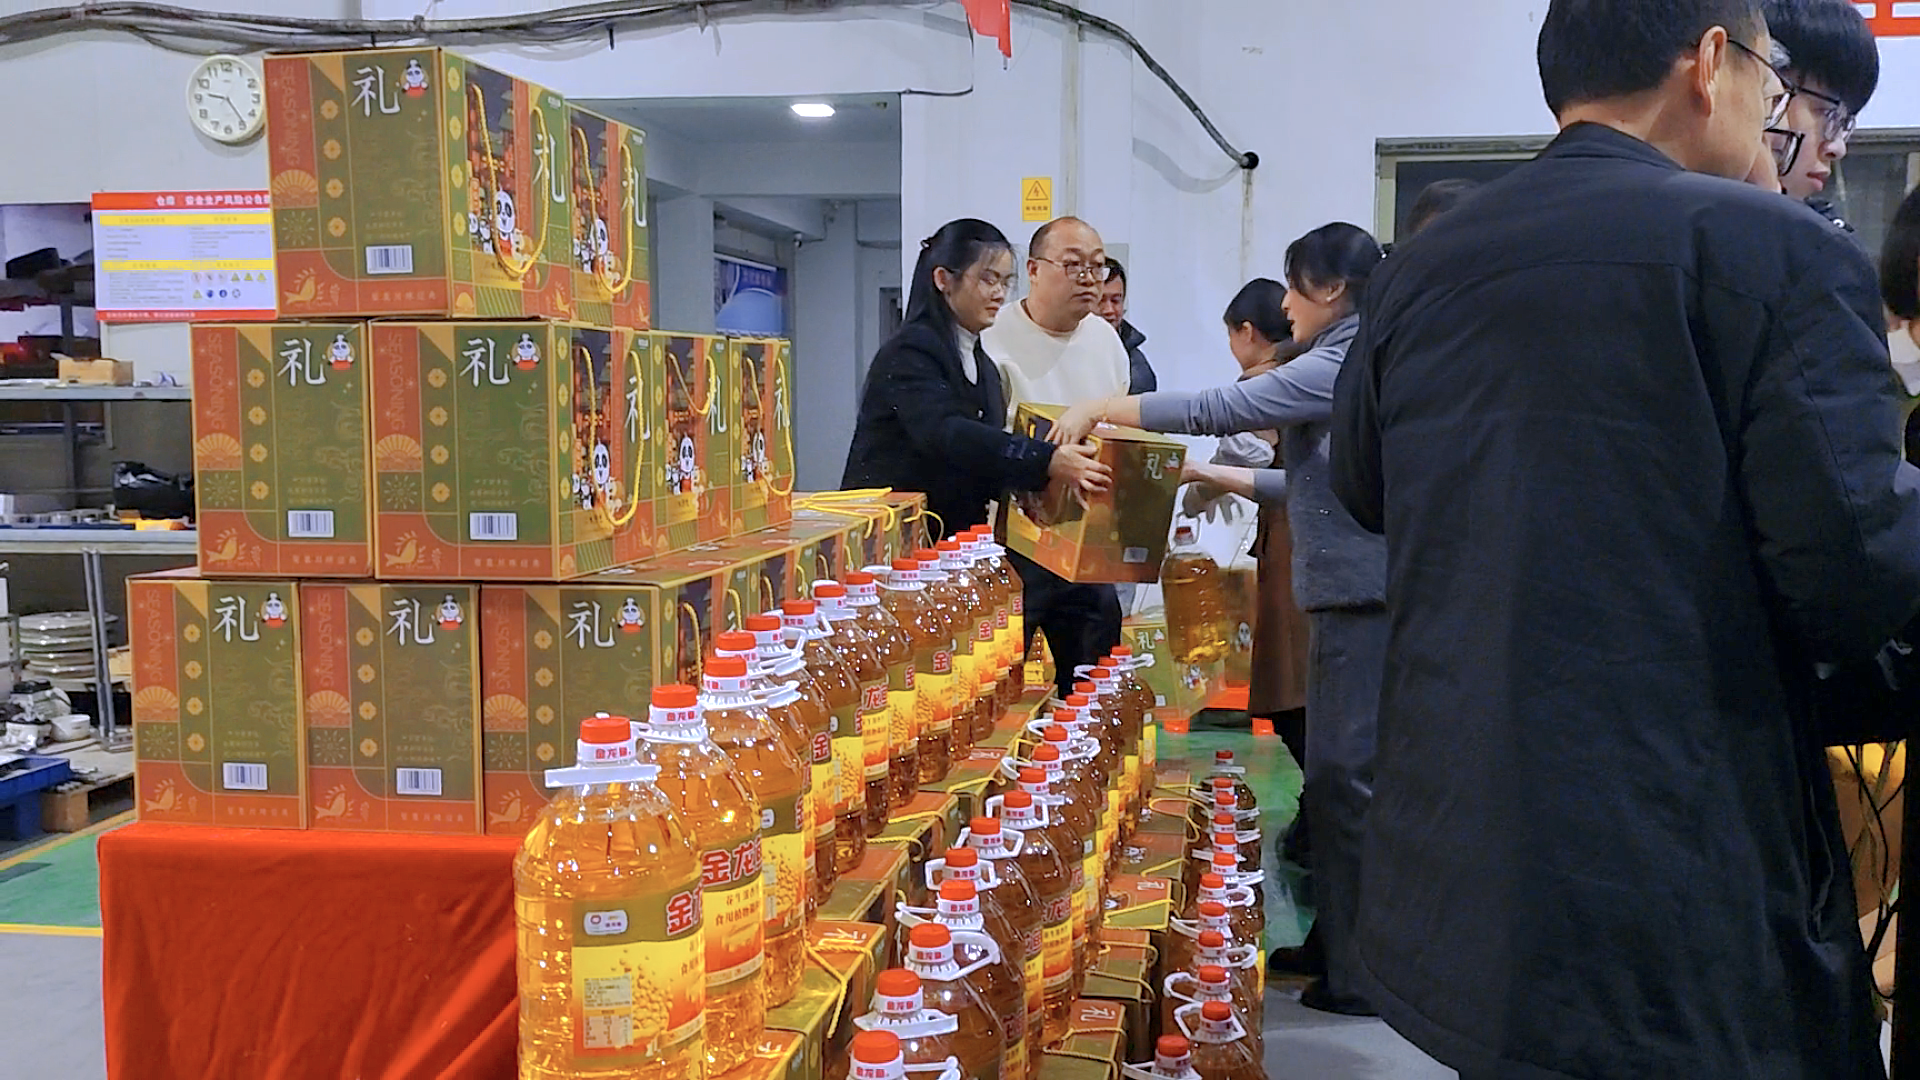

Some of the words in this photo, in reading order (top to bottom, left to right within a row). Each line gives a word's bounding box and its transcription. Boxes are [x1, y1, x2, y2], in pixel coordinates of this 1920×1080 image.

[207, 66, 218, 78] 11
[220, 61, 233, 72] 12
[238, 67, 243, 77] 1
[197, 78, 210, 90] 10
[247, 78, 256, 88] 2
[351, 65, 400, 117] 礼
[194, 93, 203, 104] 9
[251, 93, 261, 104] 3
[199, 109, 209, 119] 8
[248, 109, 256, 117] 4
[280, 64, 300, 165] SEASONING
[210, 120, 219, 131] 7
[224, 125, 233, 135] 6
[239, 121, 247, 131] 5
[277, 338, 327, 387] 礼
[459, 338, 511, 387] 礼
[207, 333, 227, 431] SEASONING
[389, 333, 406, 431] SEASONING
[212, 596, 261, 643] 礼
[386, 598, 436, 646] 礼
[564, 600, 615, 649] 礼
[146, 588, 163, 685] SEASONING
[317, 592, 334, 687] SEASONING
[978, 620, 992, 640] 金
[1136, 631, 1156, 650] 礼
[933, 650, 950, 672] 金
